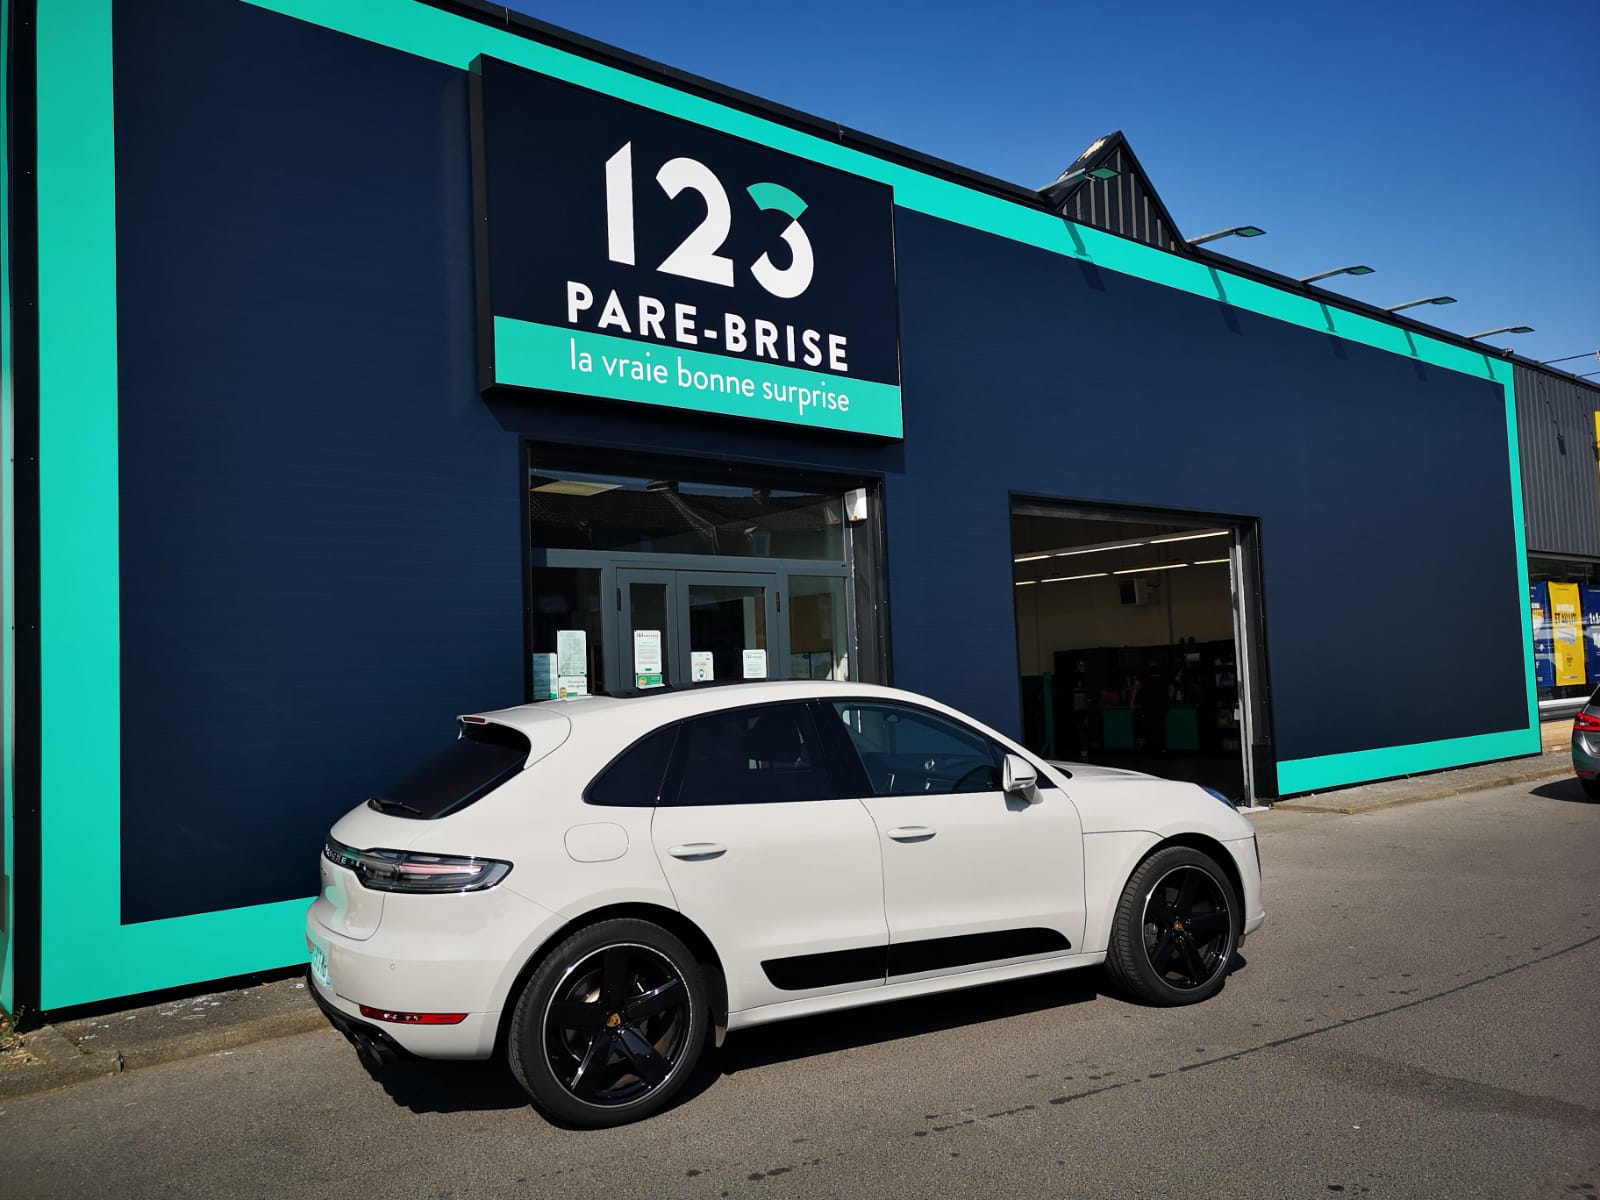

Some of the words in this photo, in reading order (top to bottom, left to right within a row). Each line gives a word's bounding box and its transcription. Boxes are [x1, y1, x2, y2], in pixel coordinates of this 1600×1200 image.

[605, 141, 814, 299] 123
[567, 280, 848, 372] PARE-BRISE
[569, 337, 593, 373] la
[601, 351, 668, 384] vraie
[677, 355, 755, 397] bonne
[762, 381, 850, 416] surprise
